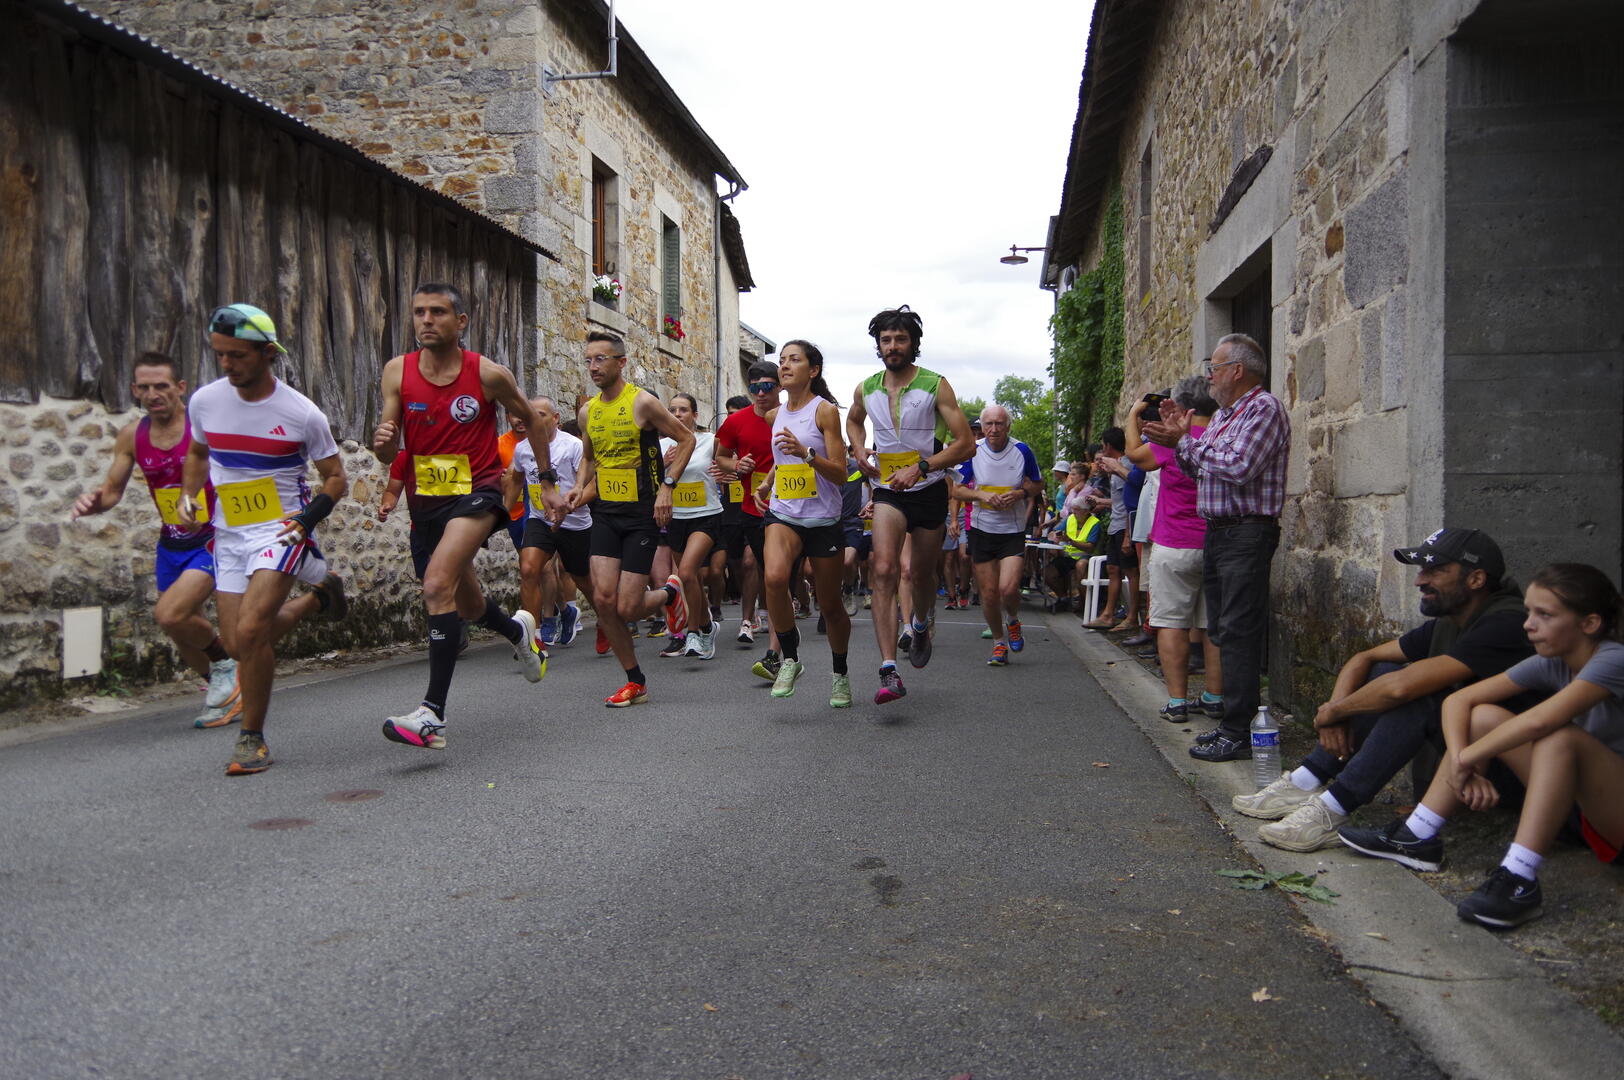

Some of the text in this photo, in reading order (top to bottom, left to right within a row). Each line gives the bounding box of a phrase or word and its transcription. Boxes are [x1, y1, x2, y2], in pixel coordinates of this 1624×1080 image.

[426, 466, 458, 485] 302
[605, 480, 628, 494] 305
[782, 476, 807, 492] 309
[231, 491, 267, 514] 310
[680, 490, 698, 502] 102
